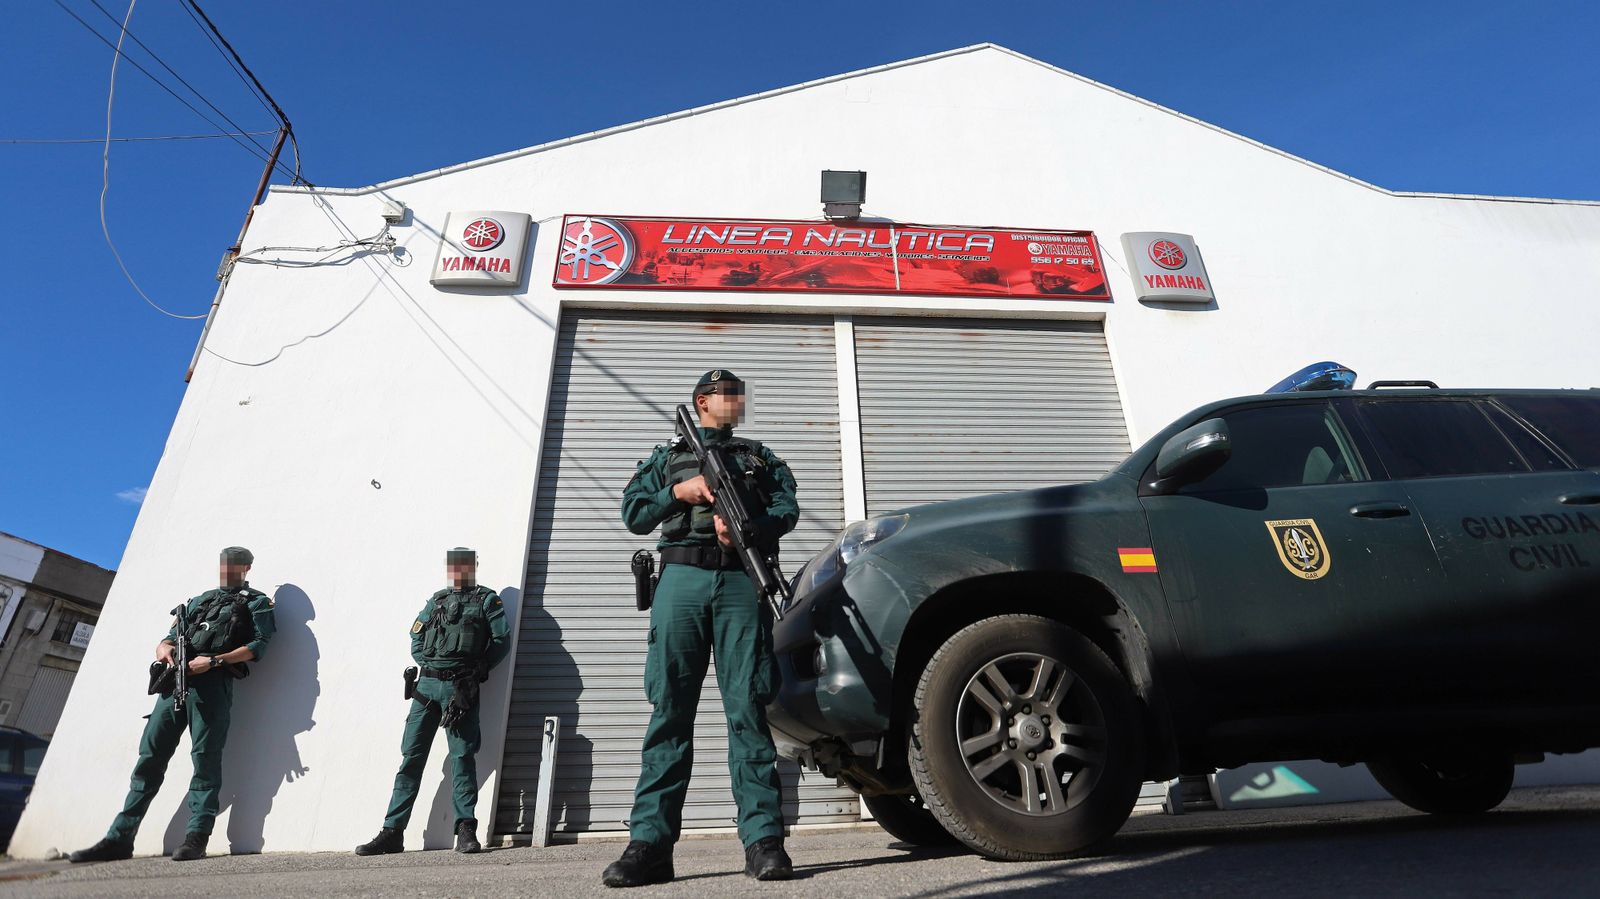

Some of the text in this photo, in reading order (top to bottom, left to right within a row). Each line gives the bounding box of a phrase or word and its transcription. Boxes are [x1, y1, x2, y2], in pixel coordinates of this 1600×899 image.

[661, 225, 995, 252] LINEA NAUTICA
[1042, 244, 1092, 256] YAMAHA
[442, 256, 511, 273] YAMAHA
[1144, 275, 1207, 290] YAMAHA
[1461, 511, 1600, 539] GUARDIA
[1509, 543, 1591, 571] CIVIL
